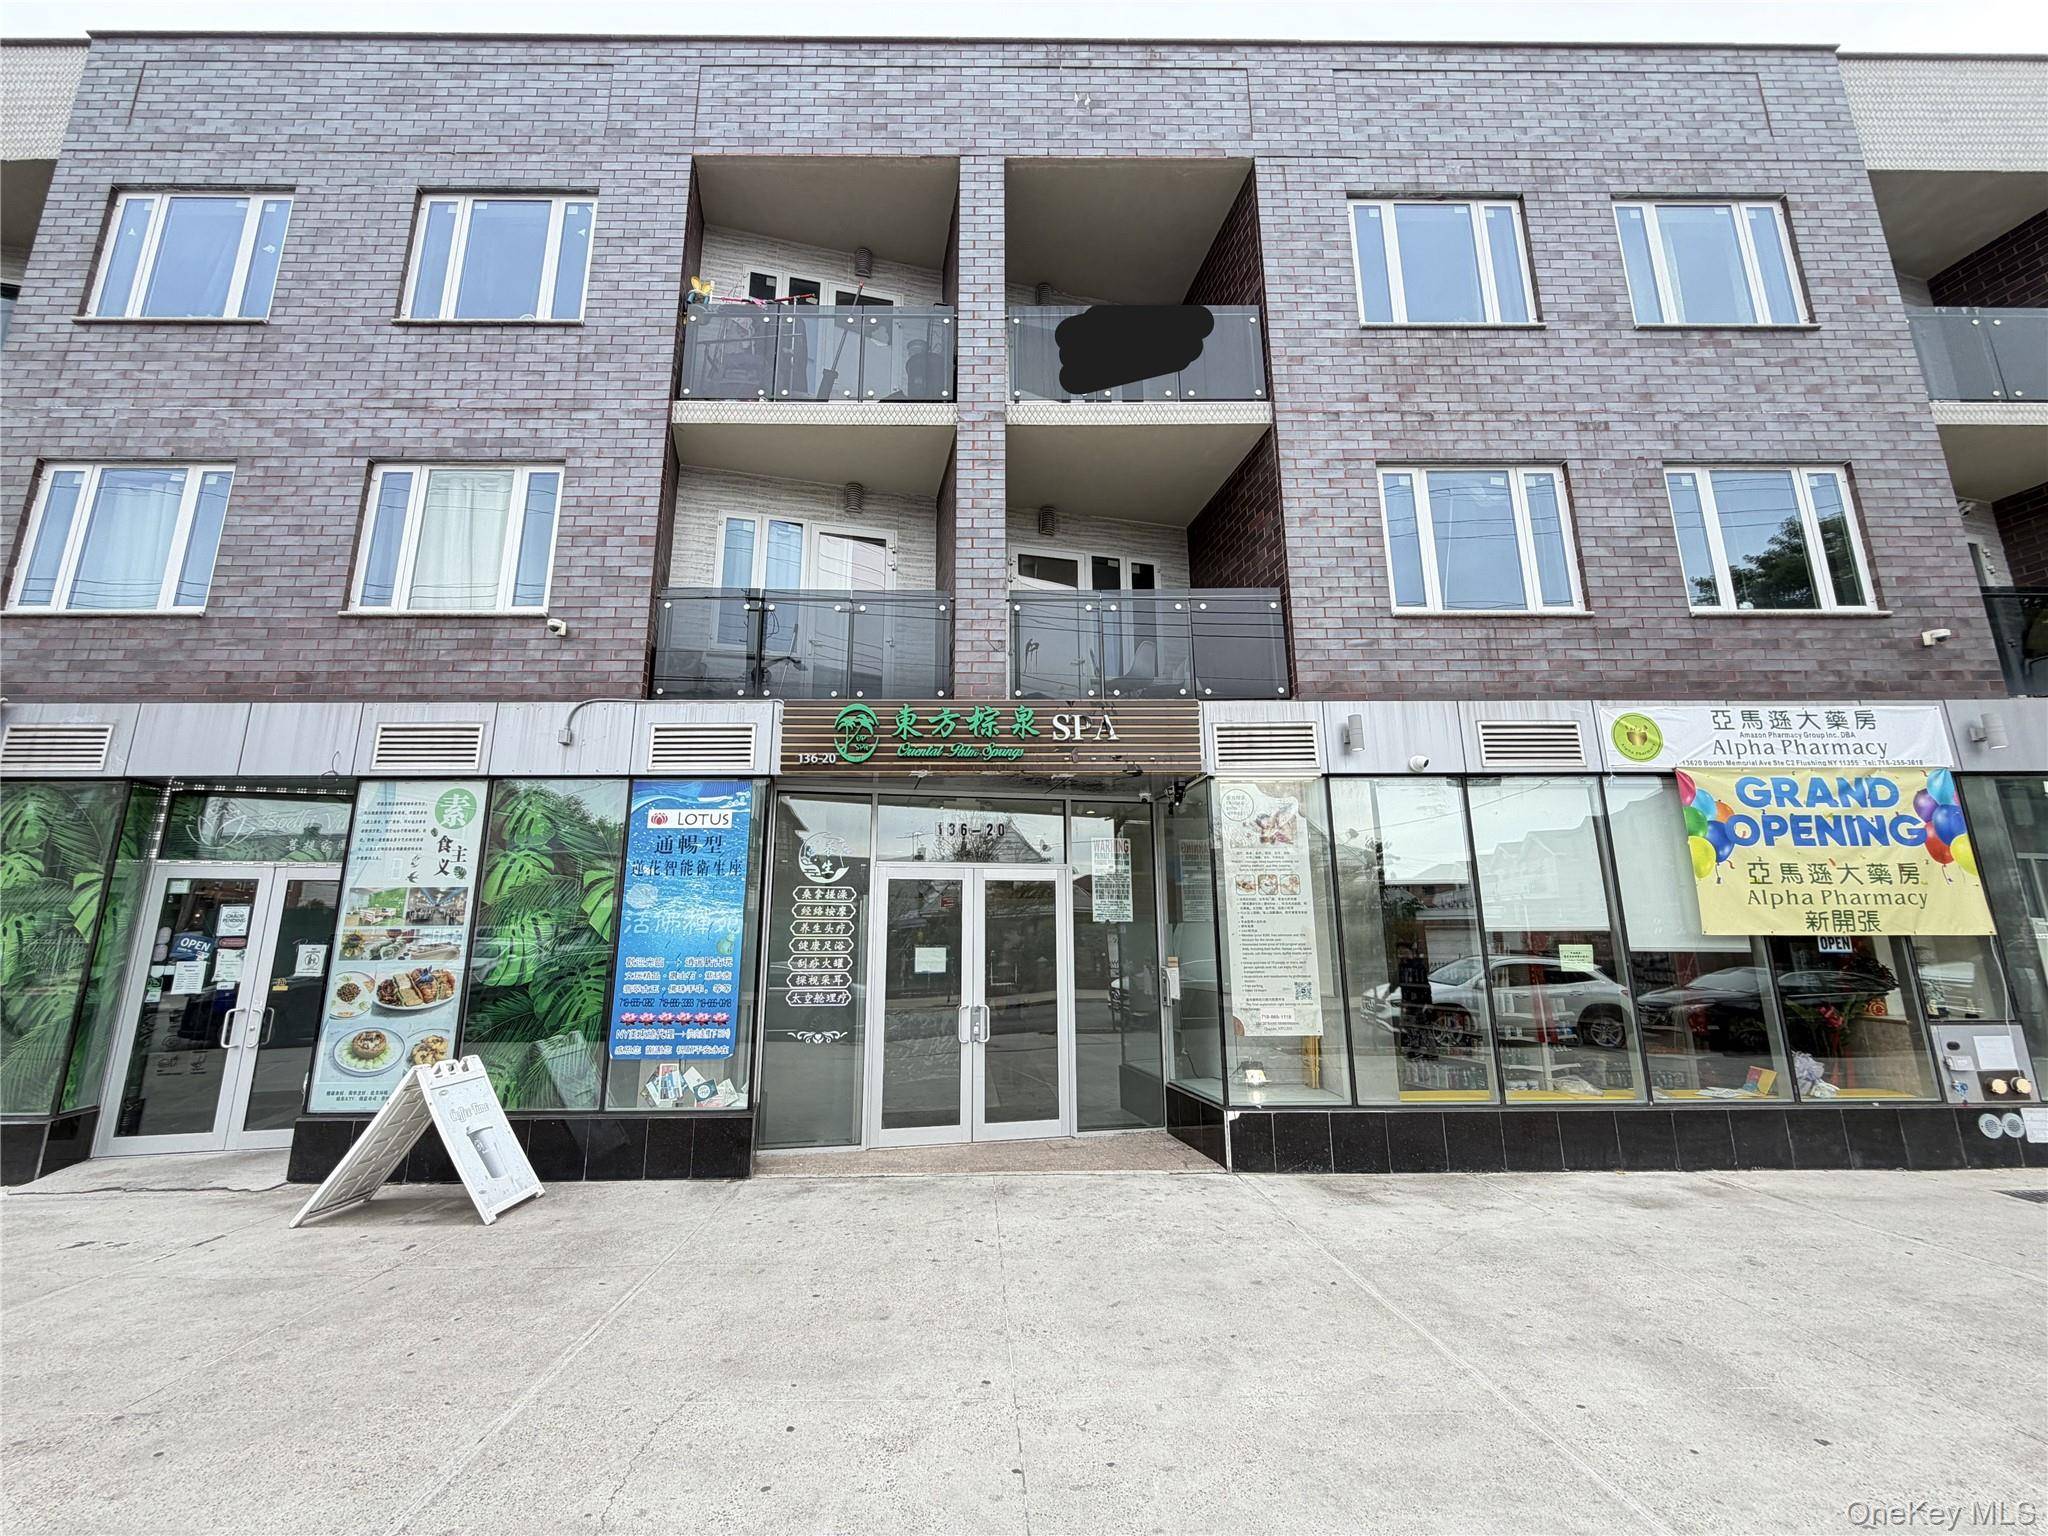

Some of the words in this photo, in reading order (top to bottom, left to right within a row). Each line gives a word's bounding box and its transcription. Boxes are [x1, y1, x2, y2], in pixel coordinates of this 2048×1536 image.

[892, 703, 1040, 739] 東方棕泉
[1052, 714, 1120, 741] SPA
[1711, 709, 1877, 731] 亞馬遜大藥房
[1767, 731, 1802, 740] Pharmacy
[1803, 731, 1825, 740] Group
[798, 753, 836, 764] 136-20
[896, 742, 942, 758] Oriental
[944, 743, 981, 758] Palm
[981, 743, 1025, 760] Springs
[1713, 740, 1775, 759] Alpha
[1782, 740, 1888, 759] Pharmacy
[1797, 759, 1826, 767] Flushing
[1735, 776, 1899, 809] GRAND
[678, 812, 729, 826] LOTUS
[1725, 814, 1928, 847] OPENING
[654, 835, 722, 854] 通暢型
[1747, 862, 1920, 885] 亞馬遜大藥房
[1748, 889, 1813, 908] Alpha
[1822, 889, 1928, 909] Pharmacy
[800, 922, 845, 934] 养生头疗
[1805, 910, 1882, 932] 新開張
[180, 937, 212, 952] OPEN
[1820, 937, 1851, 950] OPEN
[471, 1102, 490, 1115] Time
